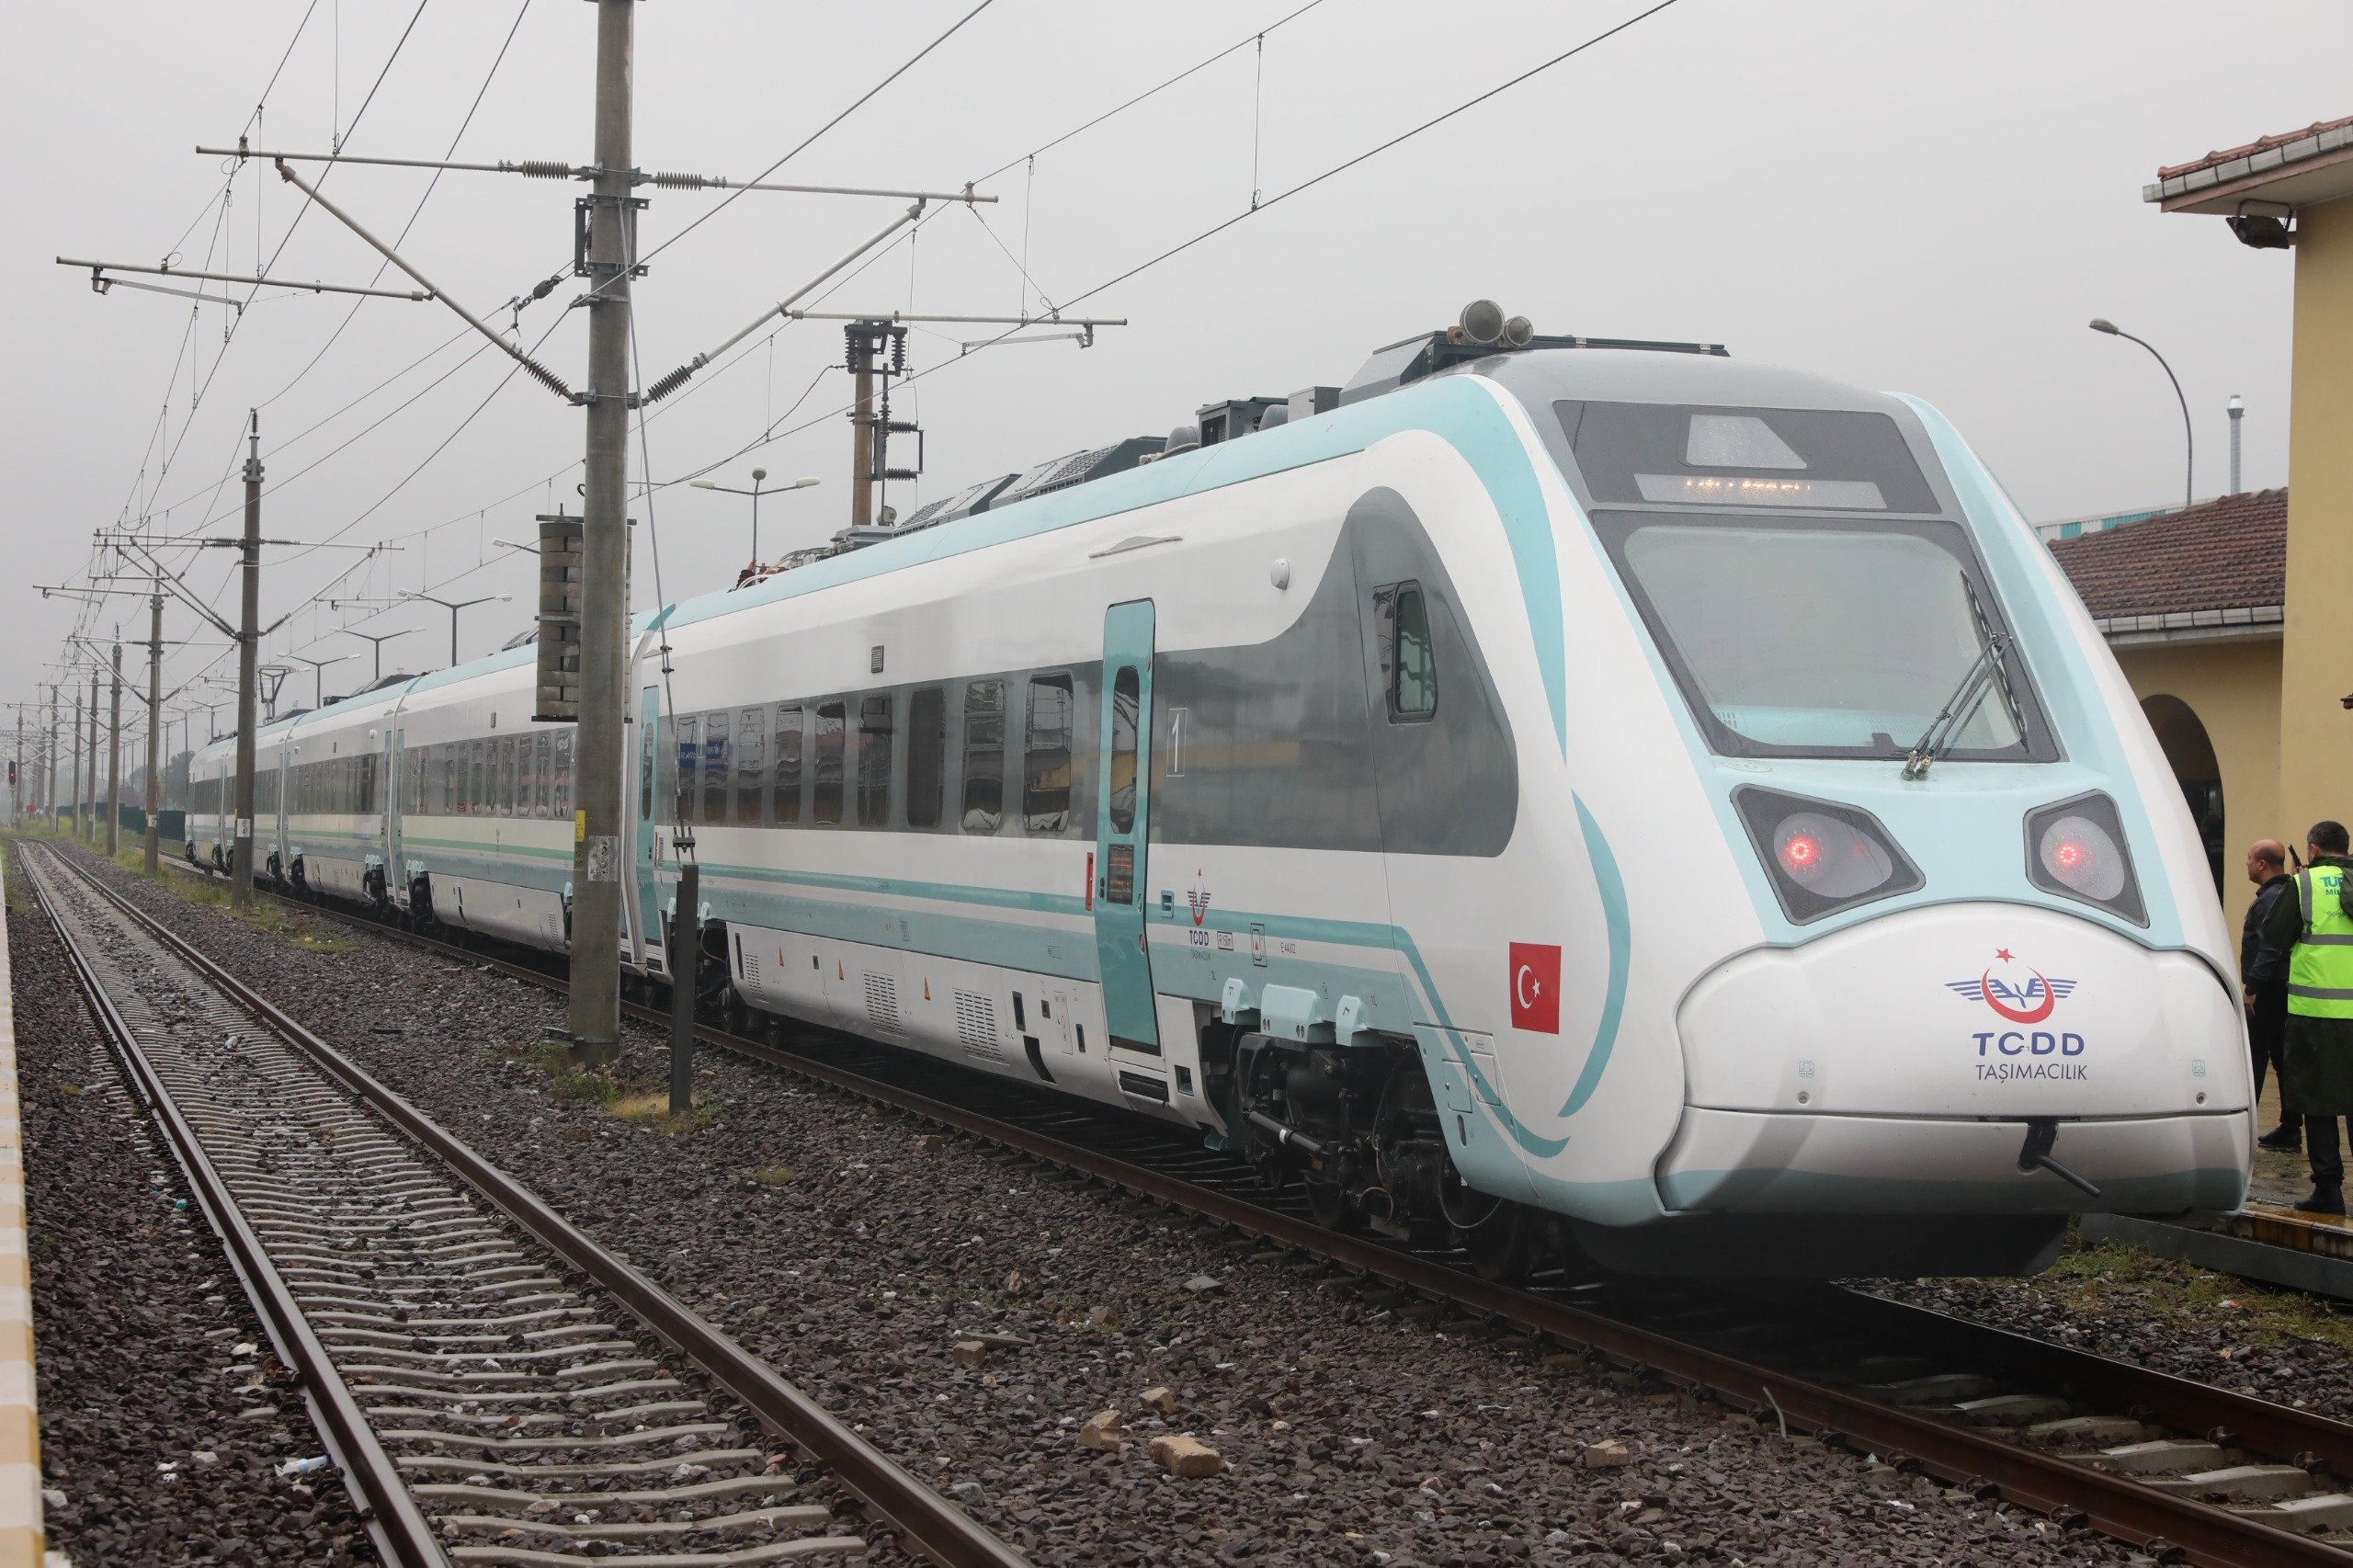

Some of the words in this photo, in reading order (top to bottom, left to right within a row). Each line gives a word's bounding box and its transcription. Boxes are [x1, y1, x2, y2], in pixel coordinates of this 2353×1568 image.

[1188, 929, 1210, 947] TCDD
[1972, 1031, 2085, 1057] TCDD
[1975, 1062, 2088, 1084] TAŞIMACILIK
